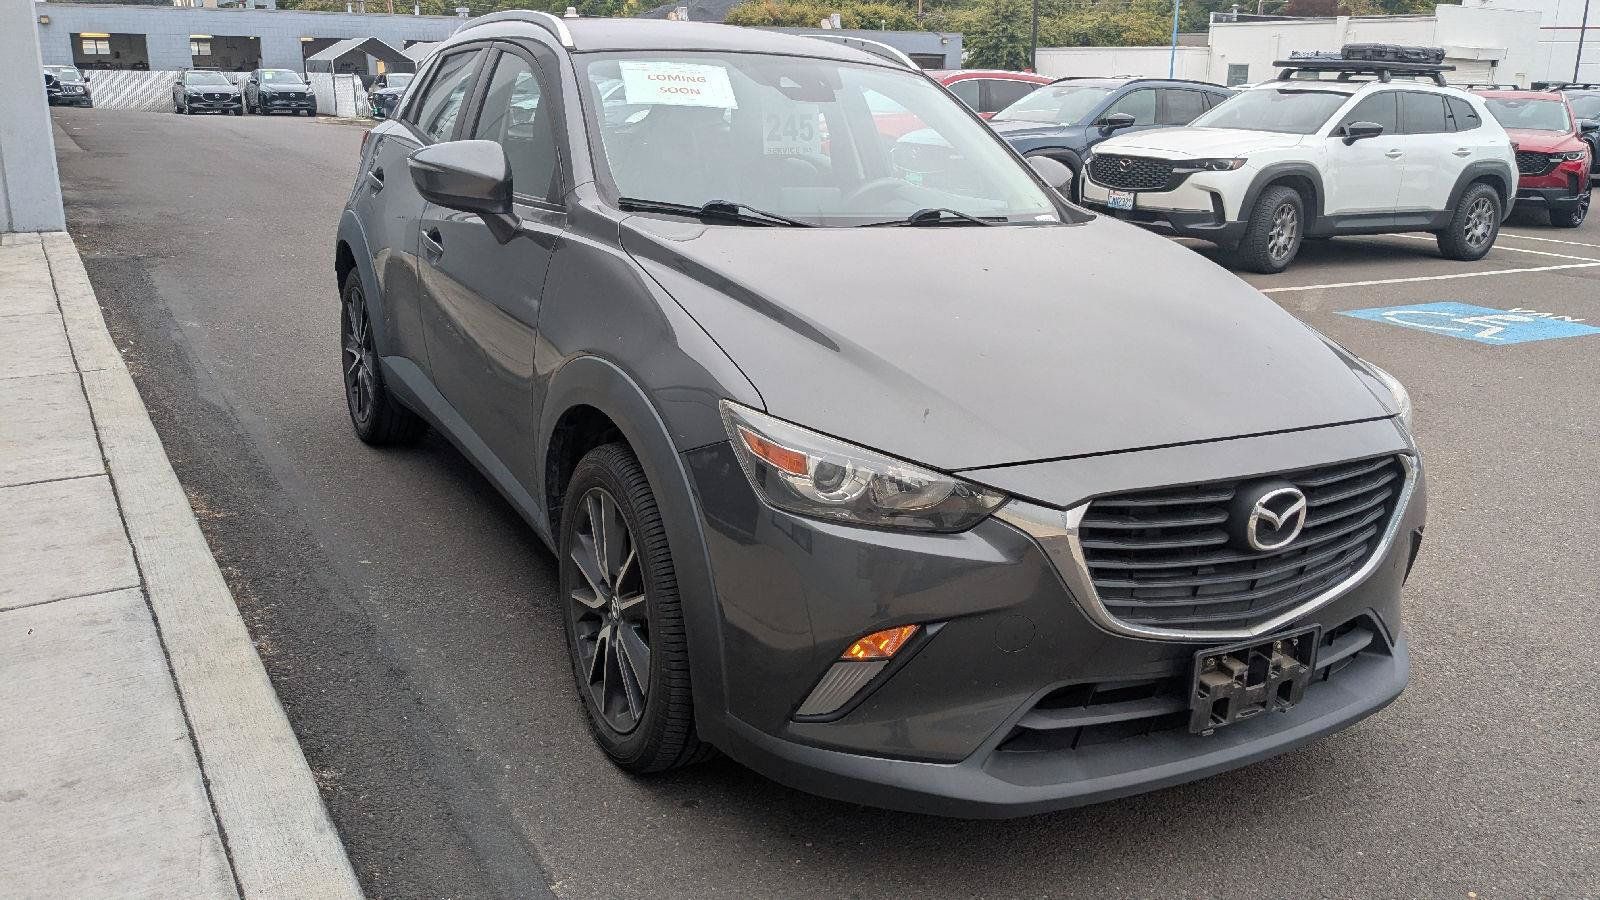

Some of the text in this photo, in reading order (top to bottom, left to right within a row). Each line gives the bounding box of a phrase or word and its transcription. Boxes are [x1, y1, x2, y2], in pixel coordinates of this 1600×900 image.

[647, 73, 707, 83] COMING
[660, 86, 702, 95] SOON
[766, 114, 814, 142] 245
